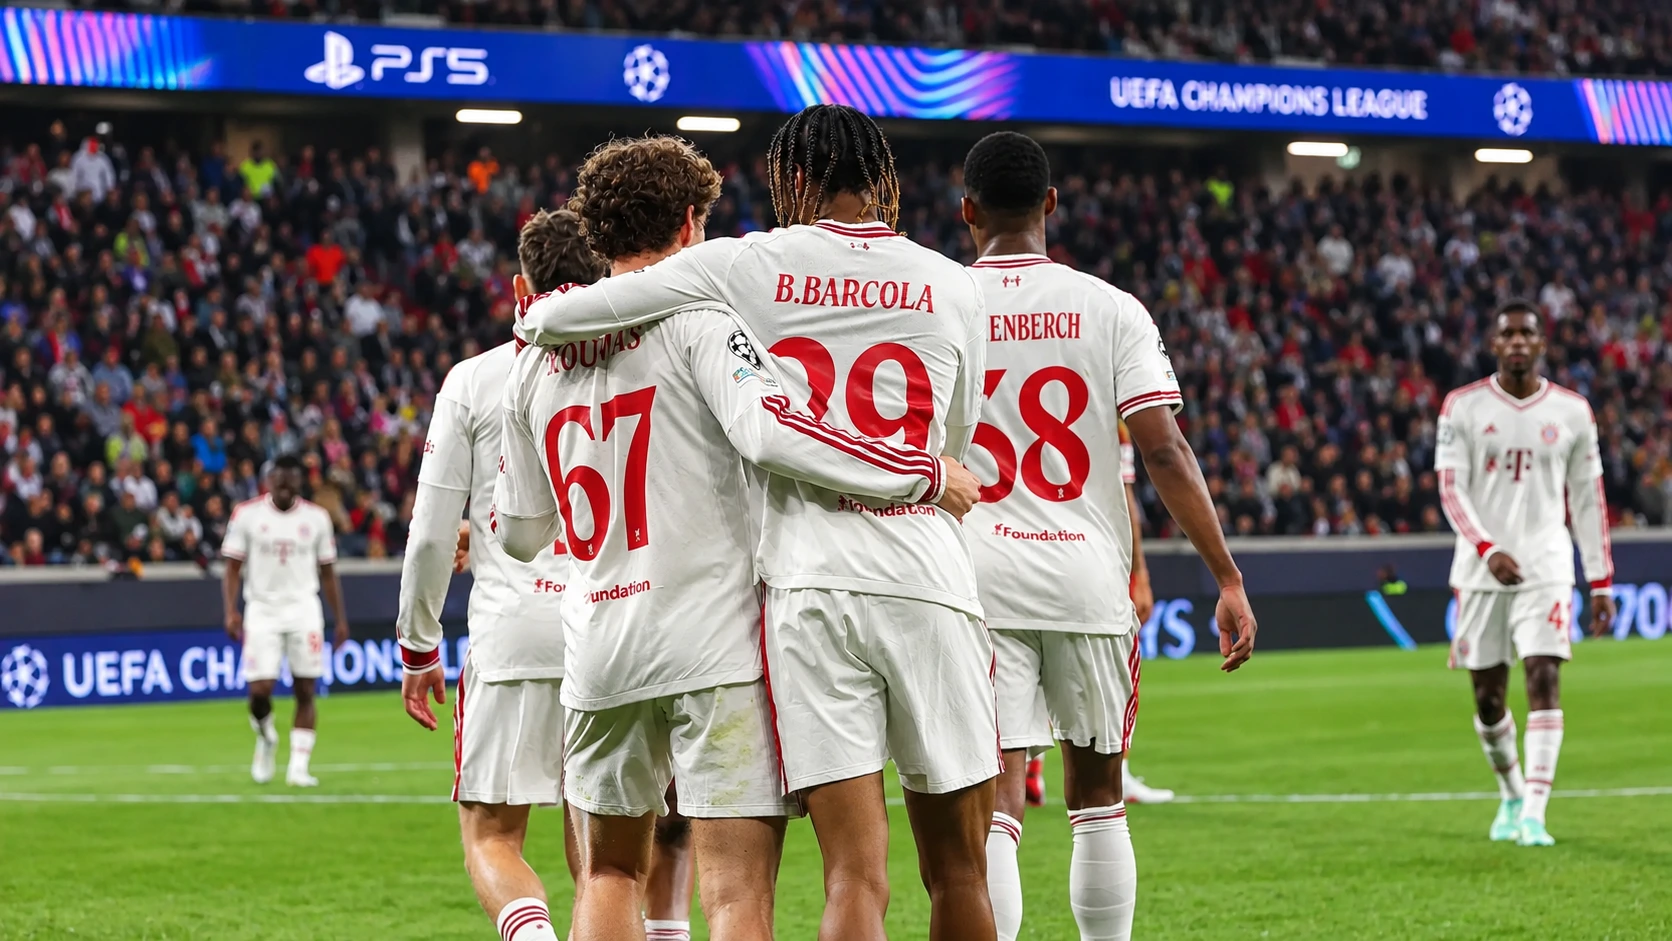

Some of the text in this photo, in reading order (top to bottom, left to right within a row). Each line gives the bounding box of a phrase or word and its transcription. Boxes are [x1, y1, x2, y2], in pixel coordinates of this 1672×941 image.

[371, 44, 489, 85] PS5
[1110, 76, 1428, 120] UEFA CHAMPIONS LEAGUE
[774, 273, 935, 314] B.BARCOLA
[545, 385, 657, 562] 67
[1003, 526, 1086, 542] Foundation
[62, 649, 173, 698] UEFA
